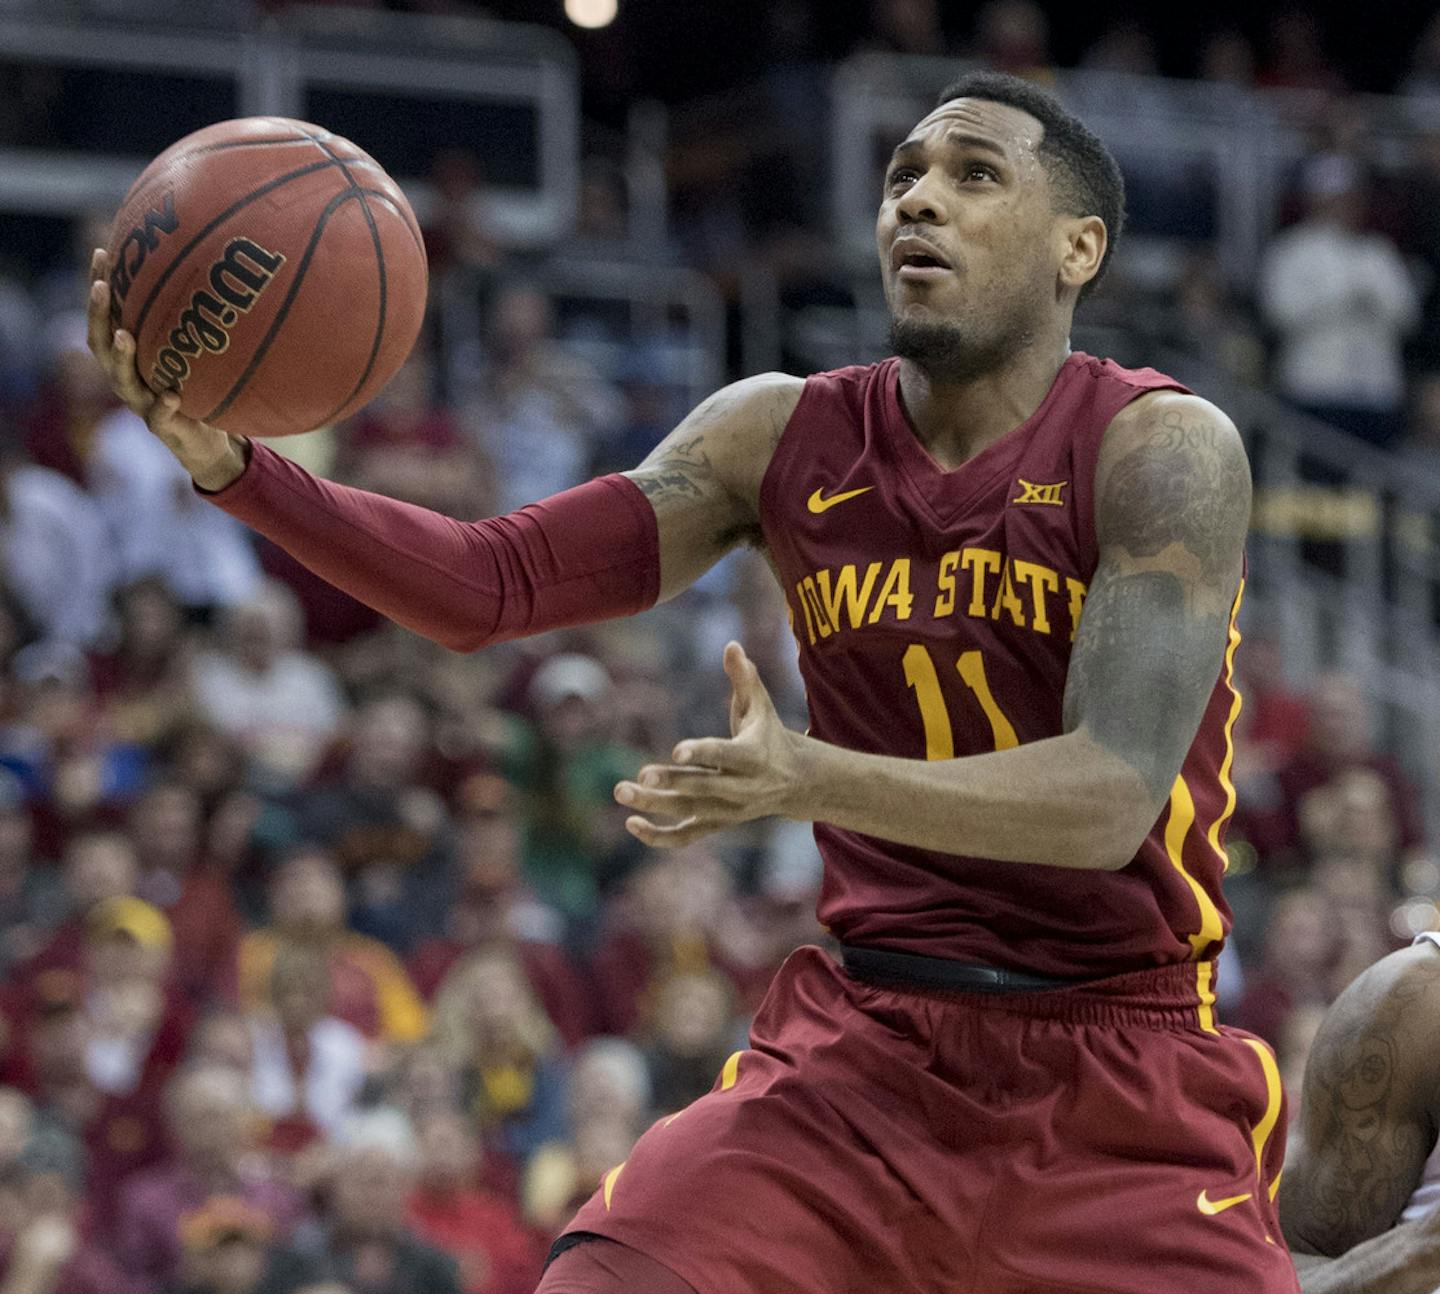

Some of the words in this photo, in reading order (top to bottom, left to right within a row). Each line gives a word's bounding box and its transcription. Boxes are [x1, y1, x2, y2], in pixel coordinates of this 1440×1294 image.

[151, 235, 287, 391] Wilson
[796, 558, 914, 646] IOWA
[902, 643, 1020, 762] 11
